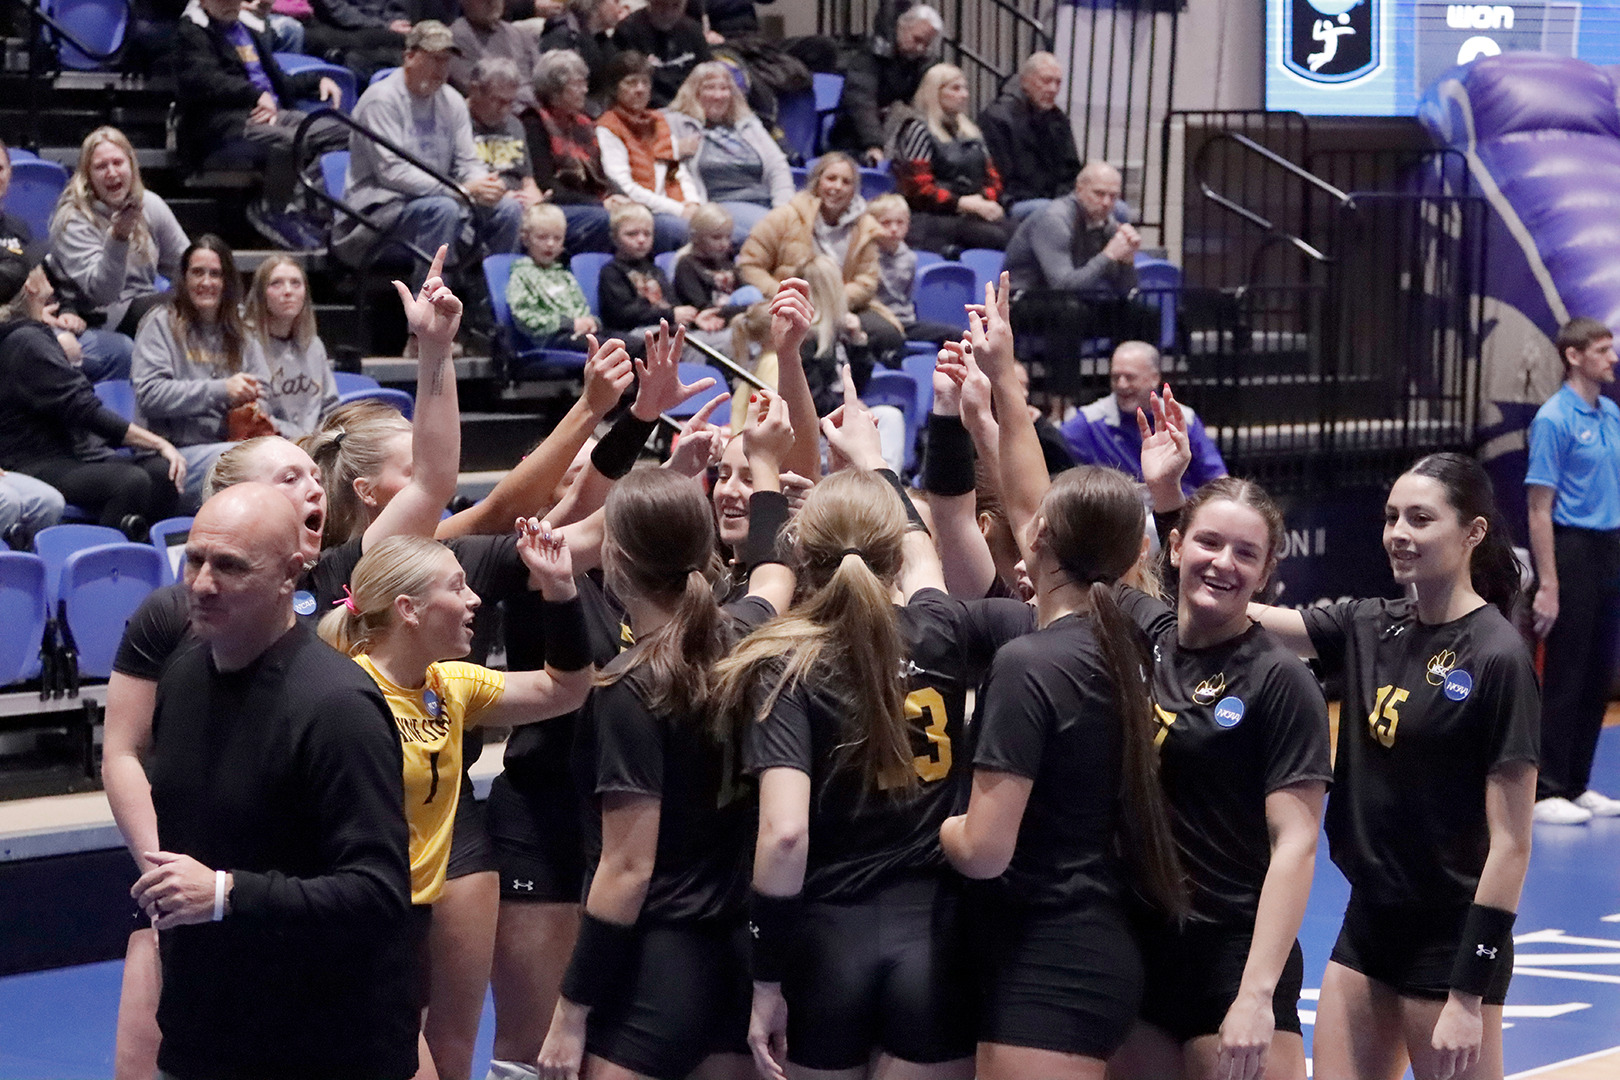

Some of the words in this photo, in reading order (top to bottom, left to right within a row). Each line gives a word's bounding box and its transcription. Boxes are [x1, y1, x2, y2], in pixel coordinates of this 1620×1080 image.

[1446, 5, 1515, 29] won
[270, 367, 320, 397] Cats
[295, 598, 316, 611] NCAA
[1446, 682, 1470, 697] NCAA
[1216, 709, 1242, 723] NCAA
[1368, 685, 1410, 749] 15
[422, 752, 440, 806] 1
